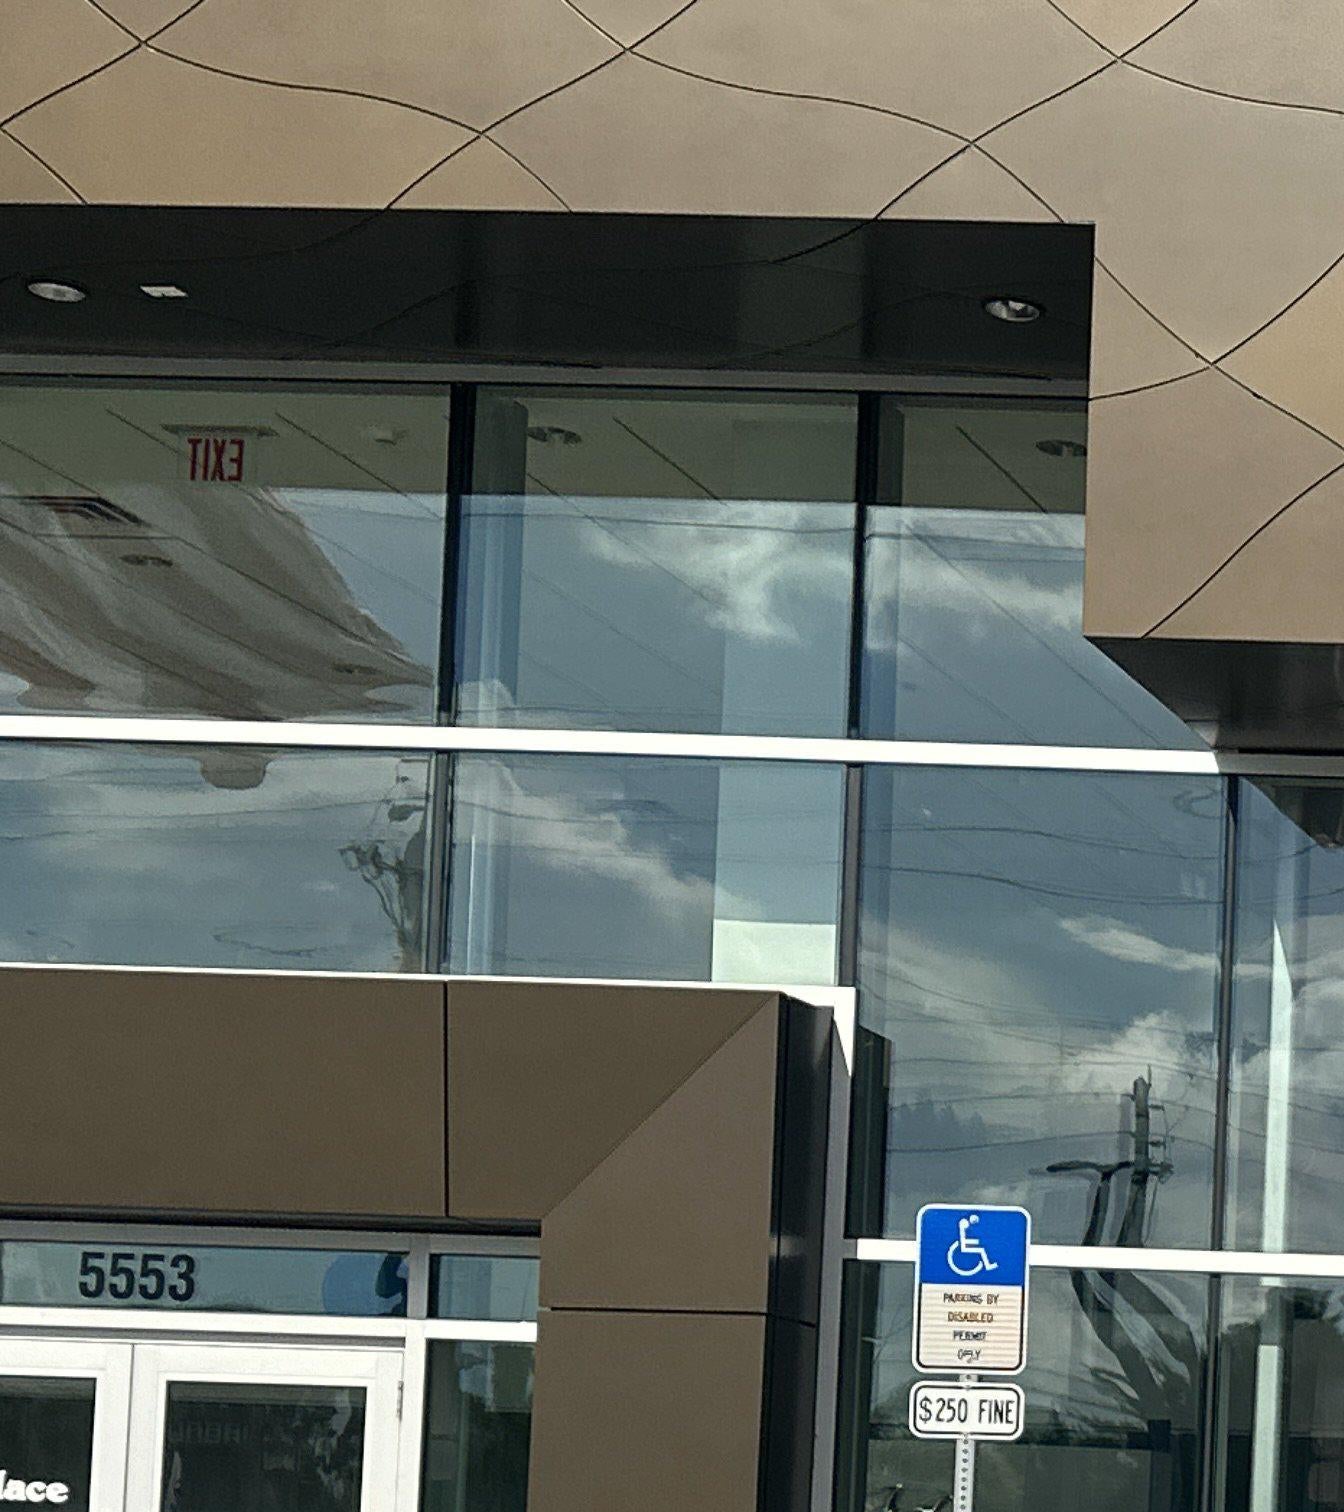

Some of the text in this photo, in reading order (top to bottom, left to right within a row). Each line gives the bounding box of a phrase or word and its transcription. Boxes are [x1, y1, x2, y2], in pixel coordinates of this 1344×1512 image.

[79, 1251, 195, 1301] 5553
[986, 1293, 1000, 1305] BY
[947, 1311, 994, 1323] DISABLED
[918, 1397, 1015, 1426] $250 FINE
